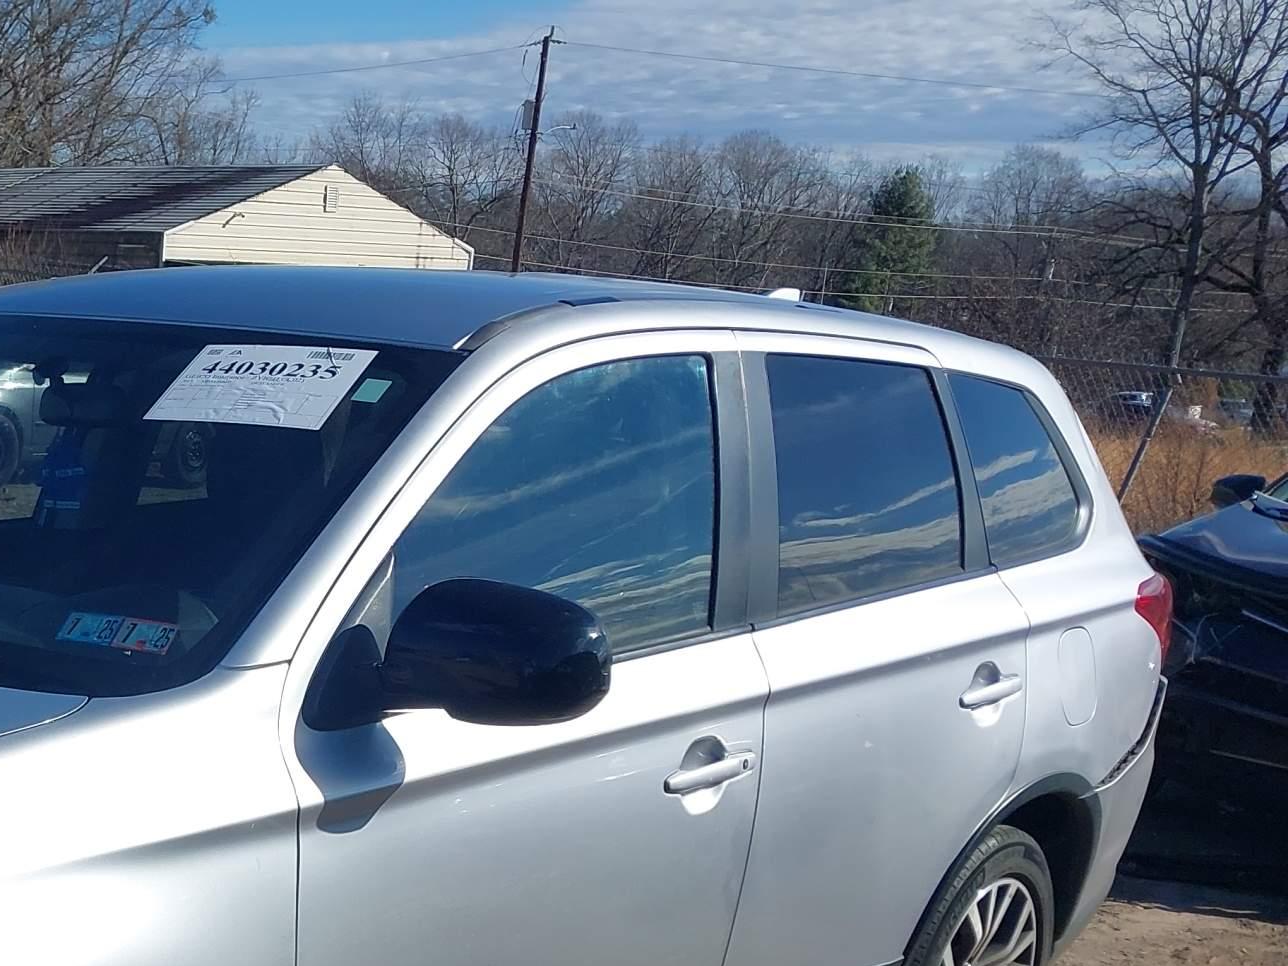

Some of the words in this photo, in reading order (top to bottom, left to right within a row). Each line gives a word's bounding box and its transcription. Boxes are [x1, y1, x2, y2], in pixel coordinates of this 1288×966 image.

[202, 361, 342, 379] 44030235
[66, 617, 82, 635] 7
[96, 619, 119, 640] 25
[122, 622, 138, 643] 7
[153, 627, 175, 649] 25
